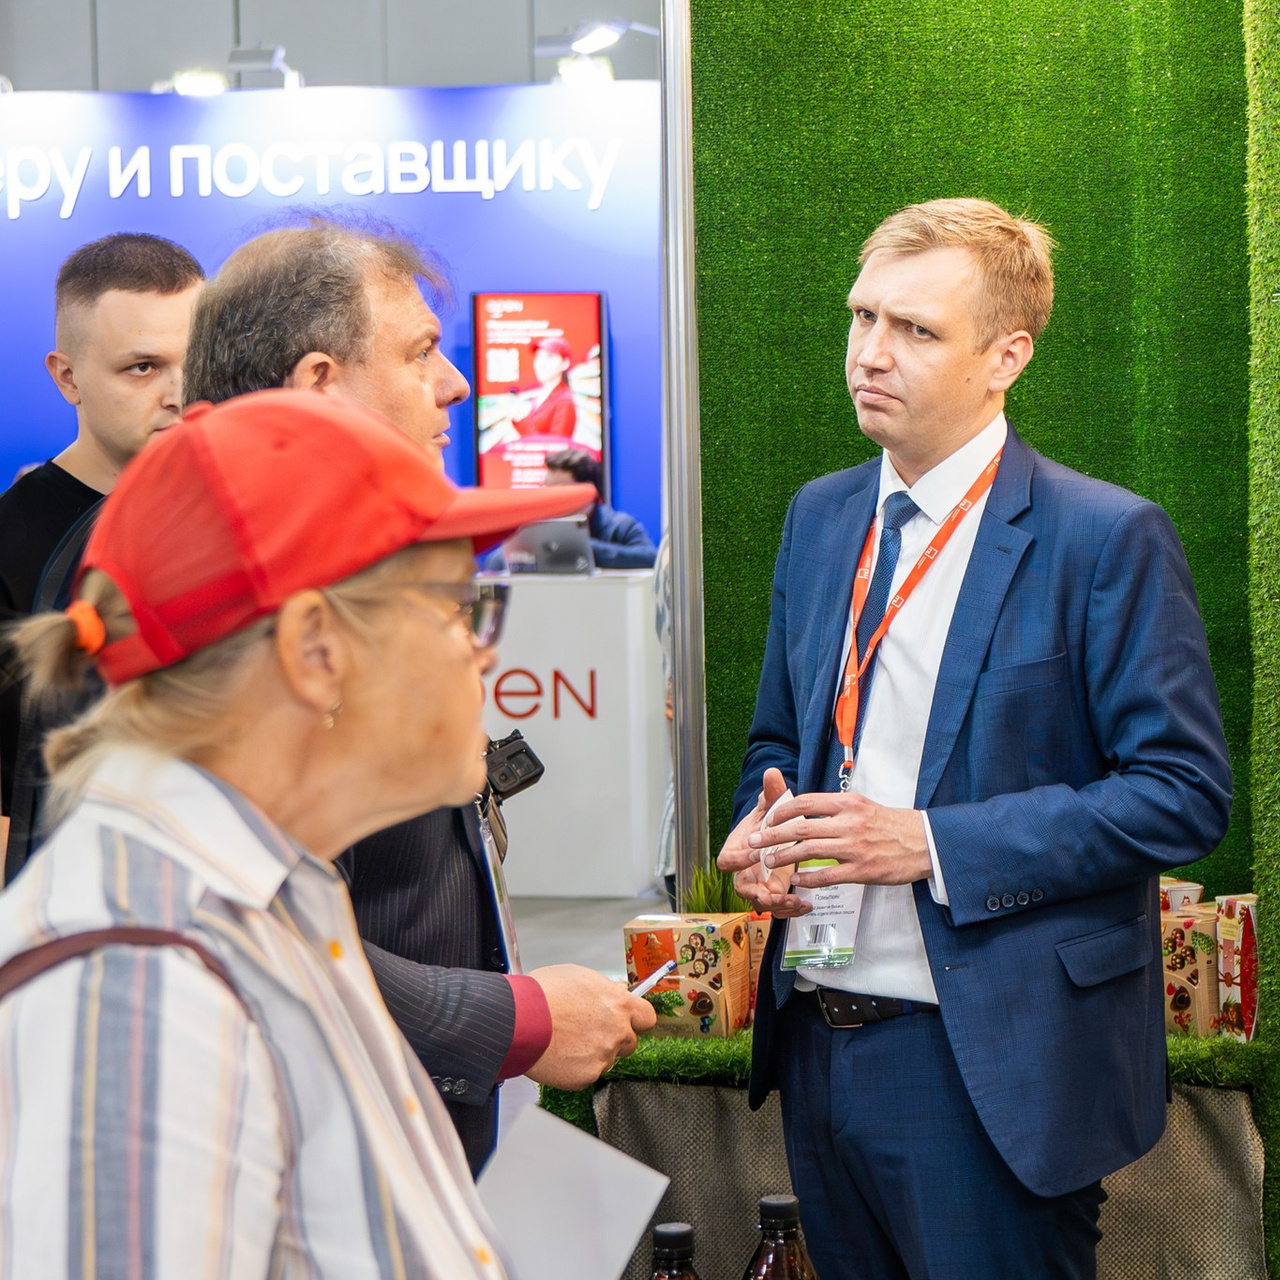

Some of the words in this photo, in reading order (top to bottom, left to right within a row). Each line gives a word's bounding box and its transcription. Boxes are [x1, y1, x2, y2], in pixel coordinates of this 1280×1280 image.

[0, 145, 94, 220] ру
[108, 145, 151, 199] и
[169, 137, 623, 210] поставщику
[493, 668, 597, 720] eN
